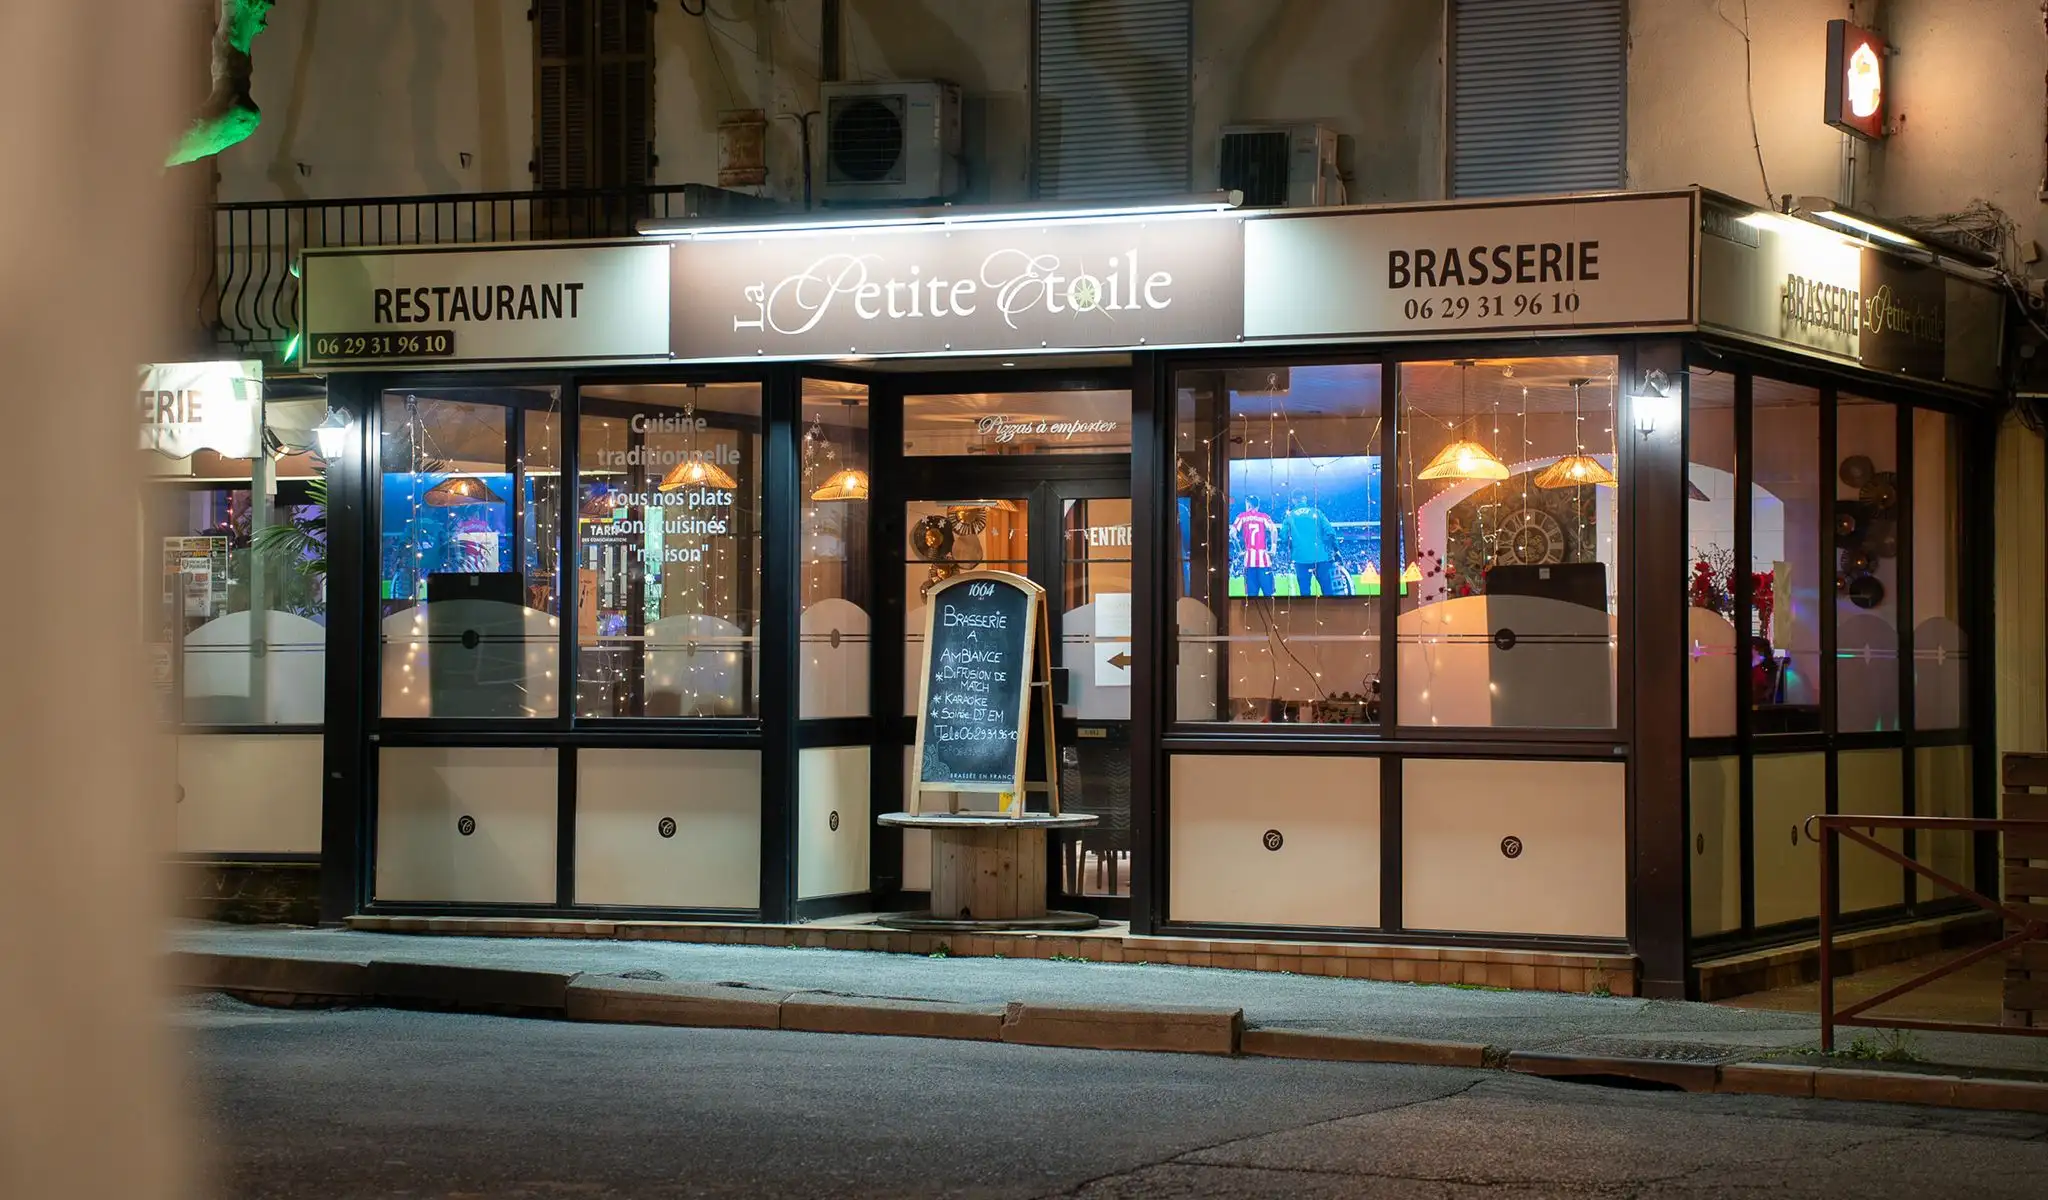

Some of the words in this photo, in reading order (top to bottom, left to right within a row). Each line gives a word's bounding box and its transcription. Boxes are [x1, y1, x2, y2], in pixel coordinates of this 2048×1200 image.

[1388, 241, 1600, 289] BRASSERIE
[374, 283, 584, 324] RESTAURANT
[733, 281, 766, 333] La
[767, 253, 977, 335] Petite
[1787, 273, 1859, 336] BRASSERIE
[1404, 298, 1433, 320] 06
[1442, 297, 1470, 319] 29
[1477, 295, 1503, 317] 31
[1513, 294, 1543, 316] 96
[1552, 291, 1580, 314] 10
[317, 337, 339, 356] 06
[344, 337, 366, 355] 29
[371, 336, 392, 354] 31
[398, 335, 420, 354] 96
[425, 335, 447, 353] 10
[631, 412, 708, 434] Cuisine
[978, 414, 1033, 443] Pizzas
[1036, 417, 1048, 434] à
[1050, 420, 1117, 440] emporter
[597, 444, 741, 466] traditionnelle
[608, 488, 648, 506] Tous
[653, 492, 684, 506] nos
[689, 487, 733, 509] plats
[1248, 523, 1260, 546] 7
[968, 582, 996, 597] 1664
[943, 604, 1007, 628] BRASSERIE
[966, 630, 978, 642] A
[939, 648, 1003, 663] AMBIANCE
[960, 680, 990, 692] MATCH
[994, 672, 1007, 681] DE
[944, 691, 988, 706] KARAOKE
[973, 708, 987, 721] DJ
